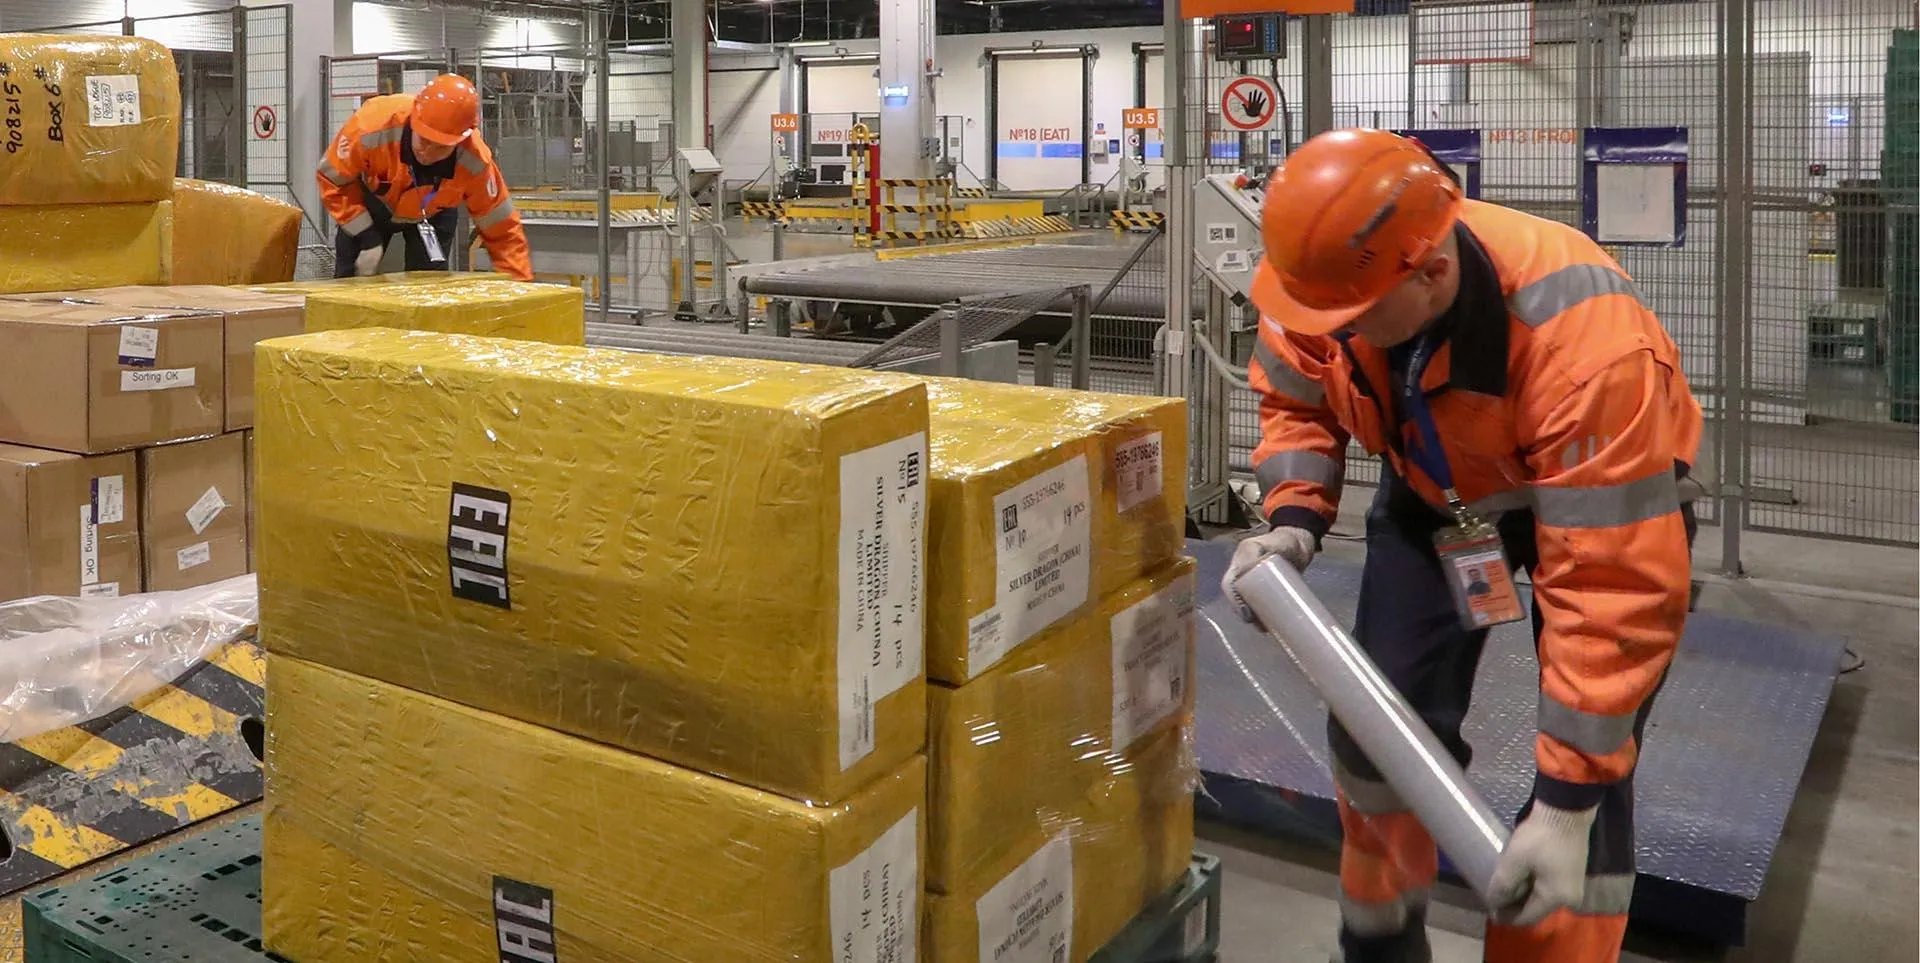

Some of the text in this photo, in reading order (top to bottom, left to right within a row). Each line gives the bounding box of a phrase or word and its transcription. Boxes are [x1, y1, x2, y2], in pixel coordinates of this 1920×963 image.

[44, 84, 60, 96] 6
[4, 80, 23, 153] 908215
[774, 118, 795, 128] U3.6
[1127, 112, 1155, 124] U3.5
[1040, 127, 1070, 141] (EAT)
[132, 371, 179, 383] Sorting OK
[450, 493, 508, 600] EAC
[856, 529, 864, 568] MADE
[86, 559, 95, 576] OK
[872, 476, 884, 667] SILVER DRAGON (CHINA)
[856, 589, 865, 632] CHINA
[892, 604, 903, 626] 14
[496, 887, 555, 963] AC
